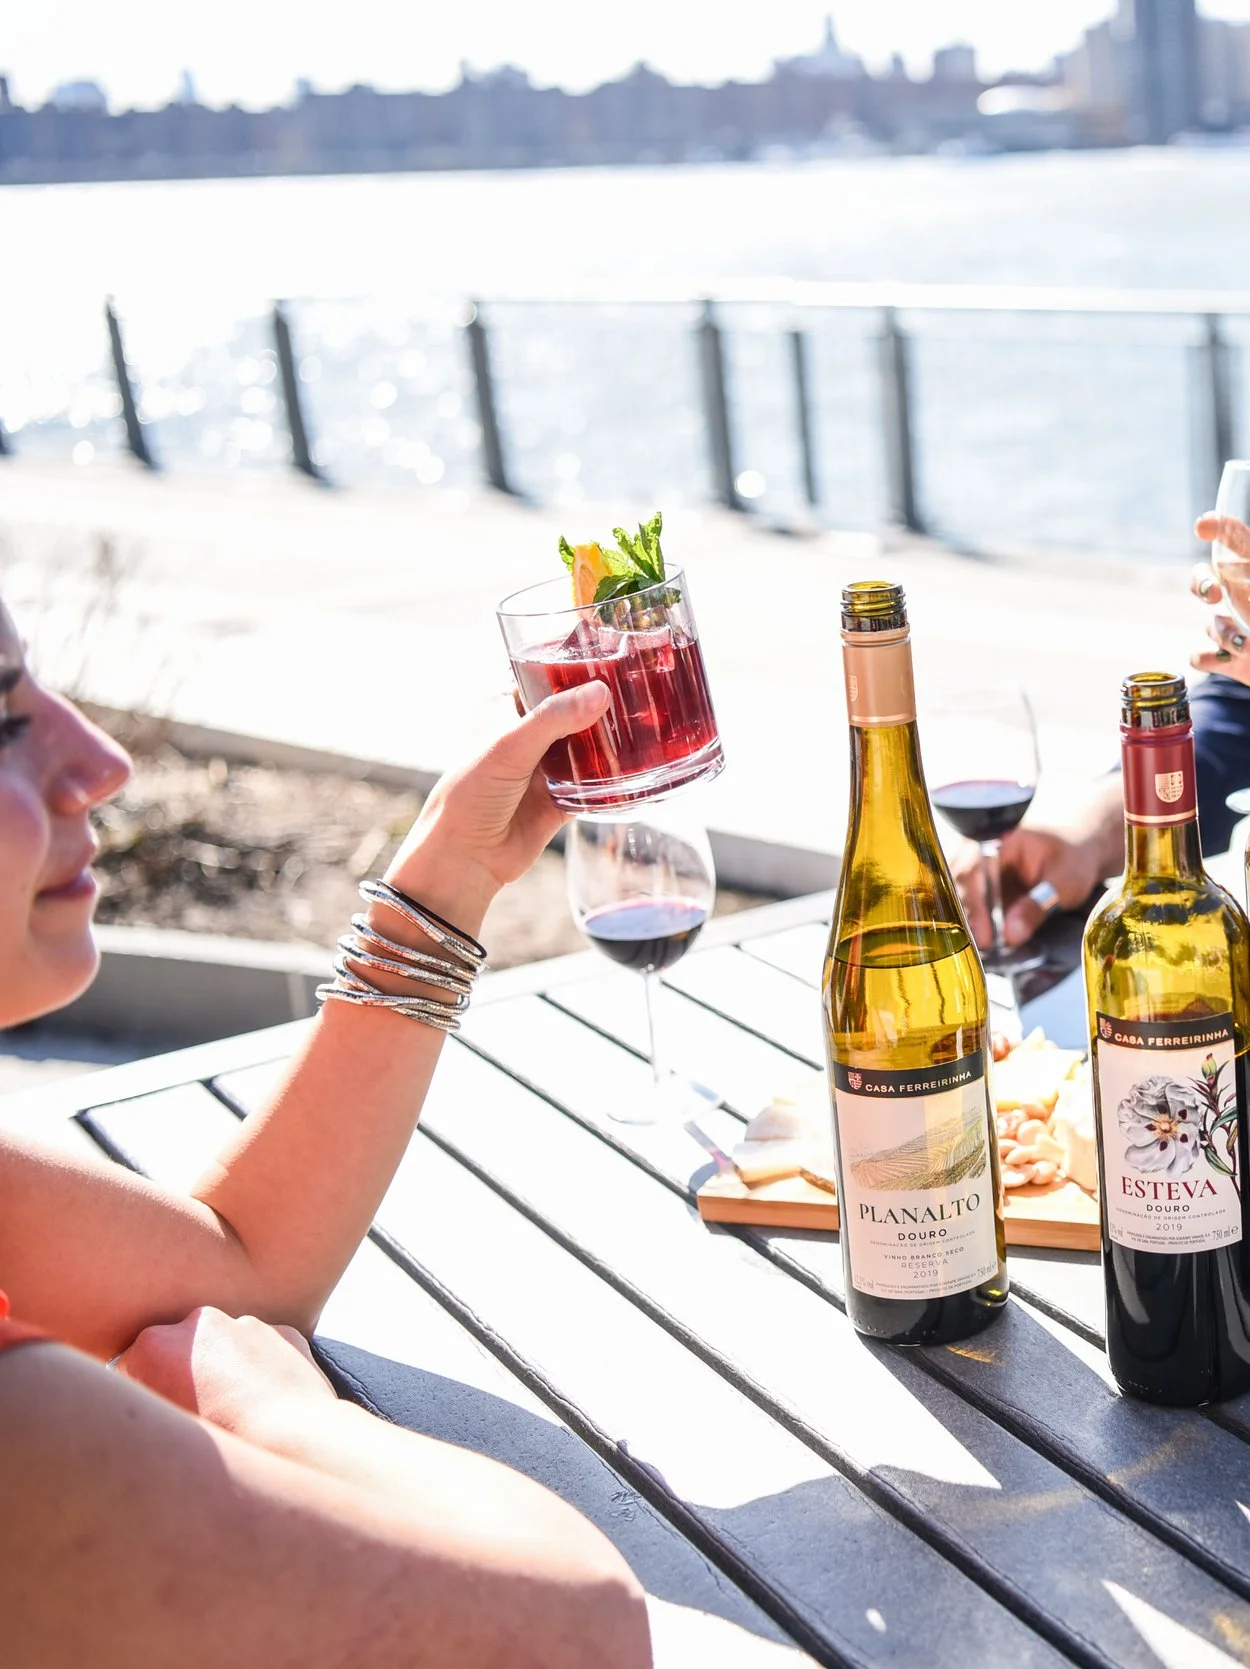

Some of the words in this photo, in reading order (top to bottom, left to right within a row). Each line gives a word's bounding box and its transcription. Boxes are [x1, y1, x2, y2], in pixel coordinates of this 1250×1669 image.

[1114, 1033, 1144, 1045] CASA
[1148, 1028, 1229, 1046] FERREIRINHA
[865, 1084, 895, 1092] CASA
[900, 1071, 972, 1092] FERREIRINHA
[1122, 1176, 1218, 1200] ESTEVA
[859, 1193, 980, 1224] PLANALTO
[1146, 1204, 1190, 1212] DOURO
[1156, 1223, 1182, 1231] 2019
[898, 1229, 946, 1241] DOURO
[911, 1251, 942, 1260] BRANCO
[946, 1246, 964, 1256] SECO
[901, 1259, 948, 1269] RESERVA
[913, 1269, 939, 1279] 2019
